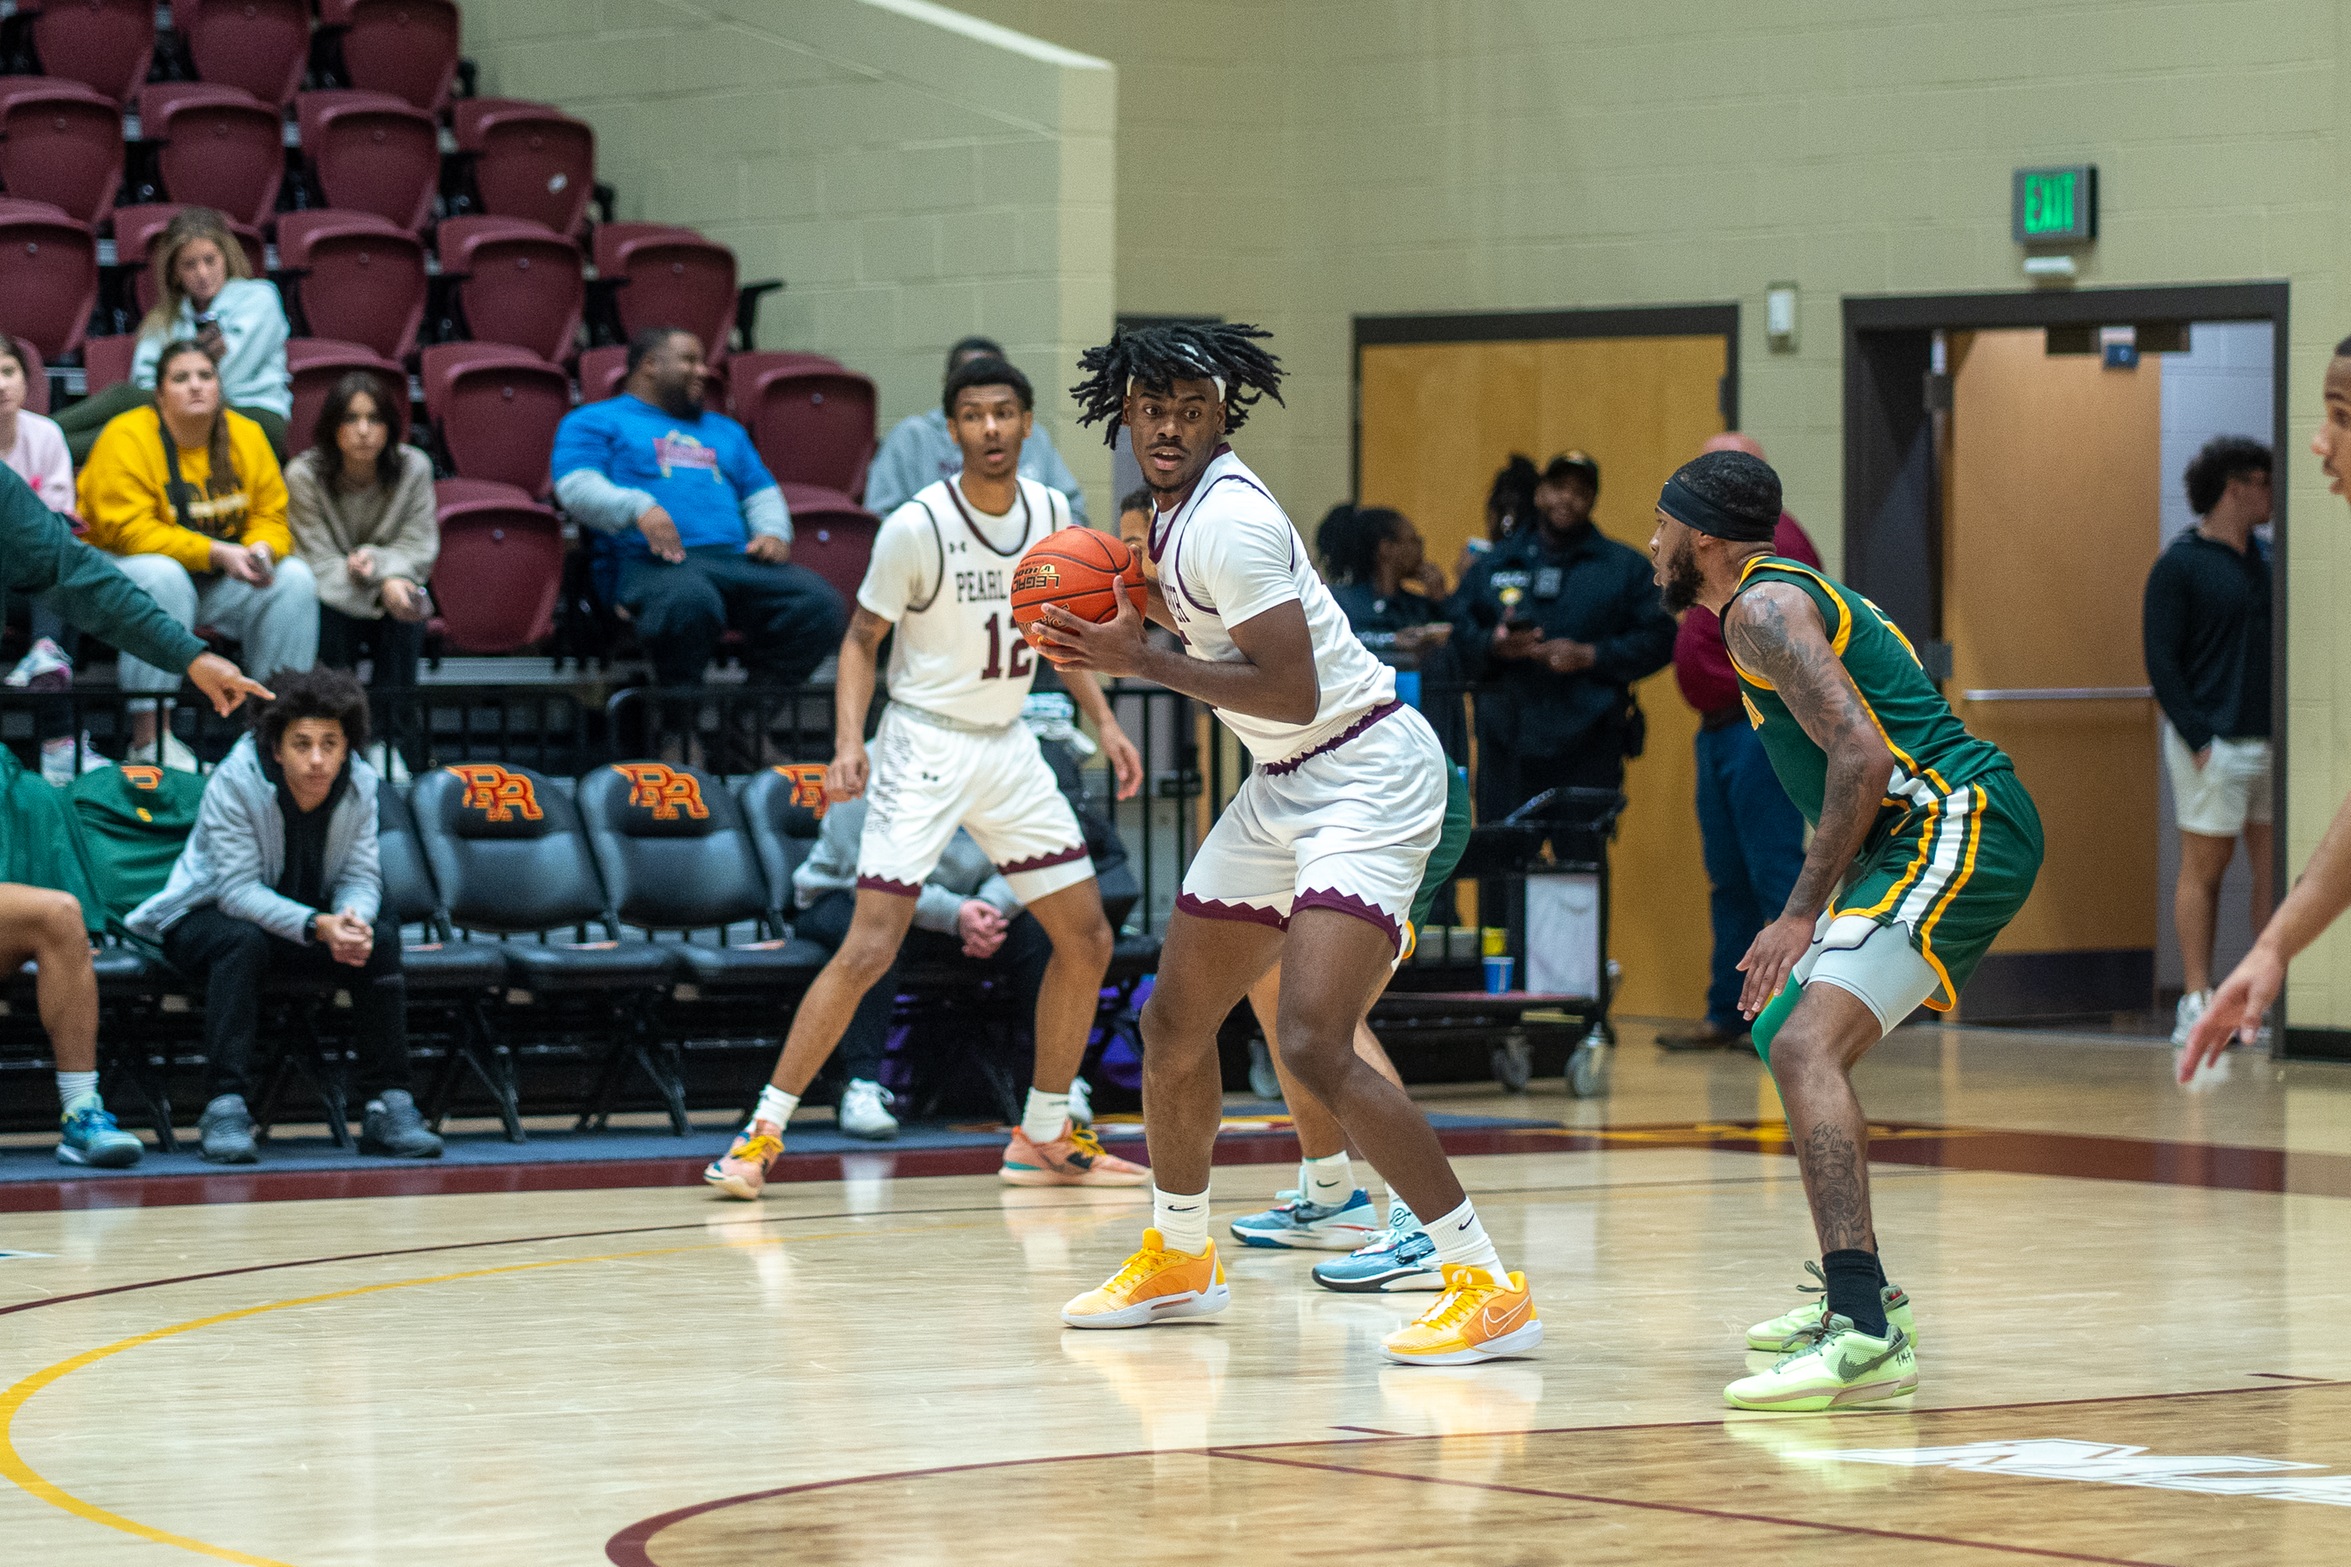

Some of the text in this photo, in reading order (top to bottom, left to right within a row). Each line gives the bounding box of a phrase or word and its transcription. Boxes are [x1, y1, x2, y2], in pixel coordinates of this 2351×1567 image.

[2024, 172, 2075, 233] EXIT
[956, 570, 1007, 603] PEARL
[1010, 575, 1060, 594] LEGAC
[981, 612, 1032, 680] 12
